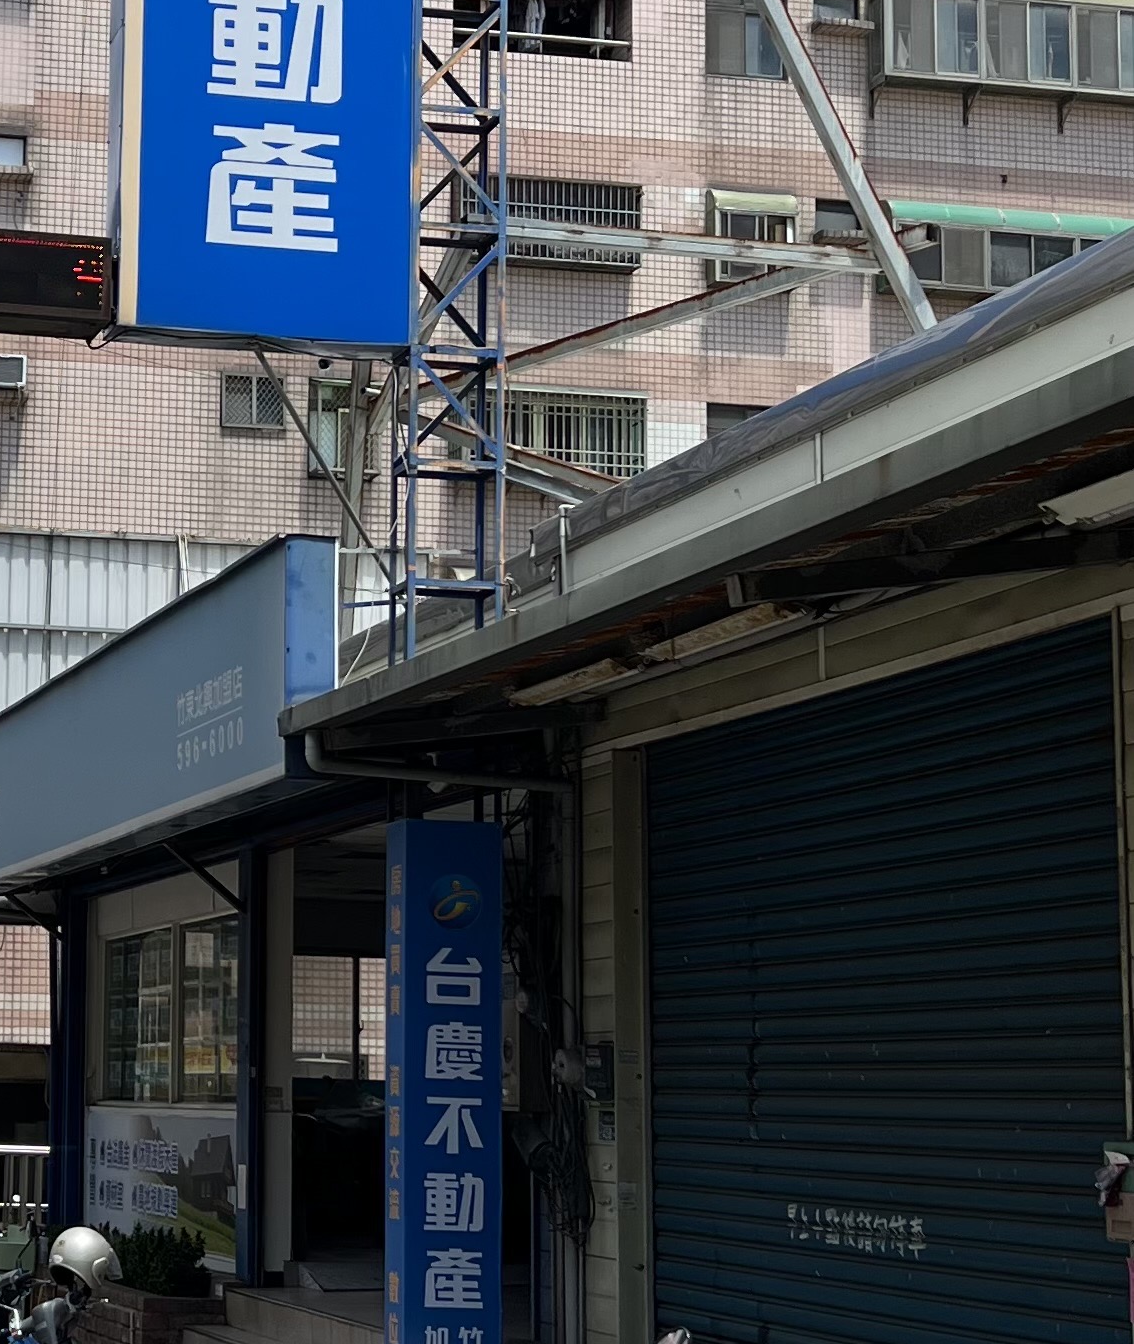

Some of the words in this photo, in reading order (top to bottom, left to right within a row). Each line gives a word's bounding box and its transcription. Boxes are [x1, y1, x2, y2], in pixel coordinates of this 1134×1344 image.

[176, 665, 243, 727] 竹東北興加盟店
[177, 716, 244, 771] 596-6000
[423, 946, 484, 1310] 台慶不動產
